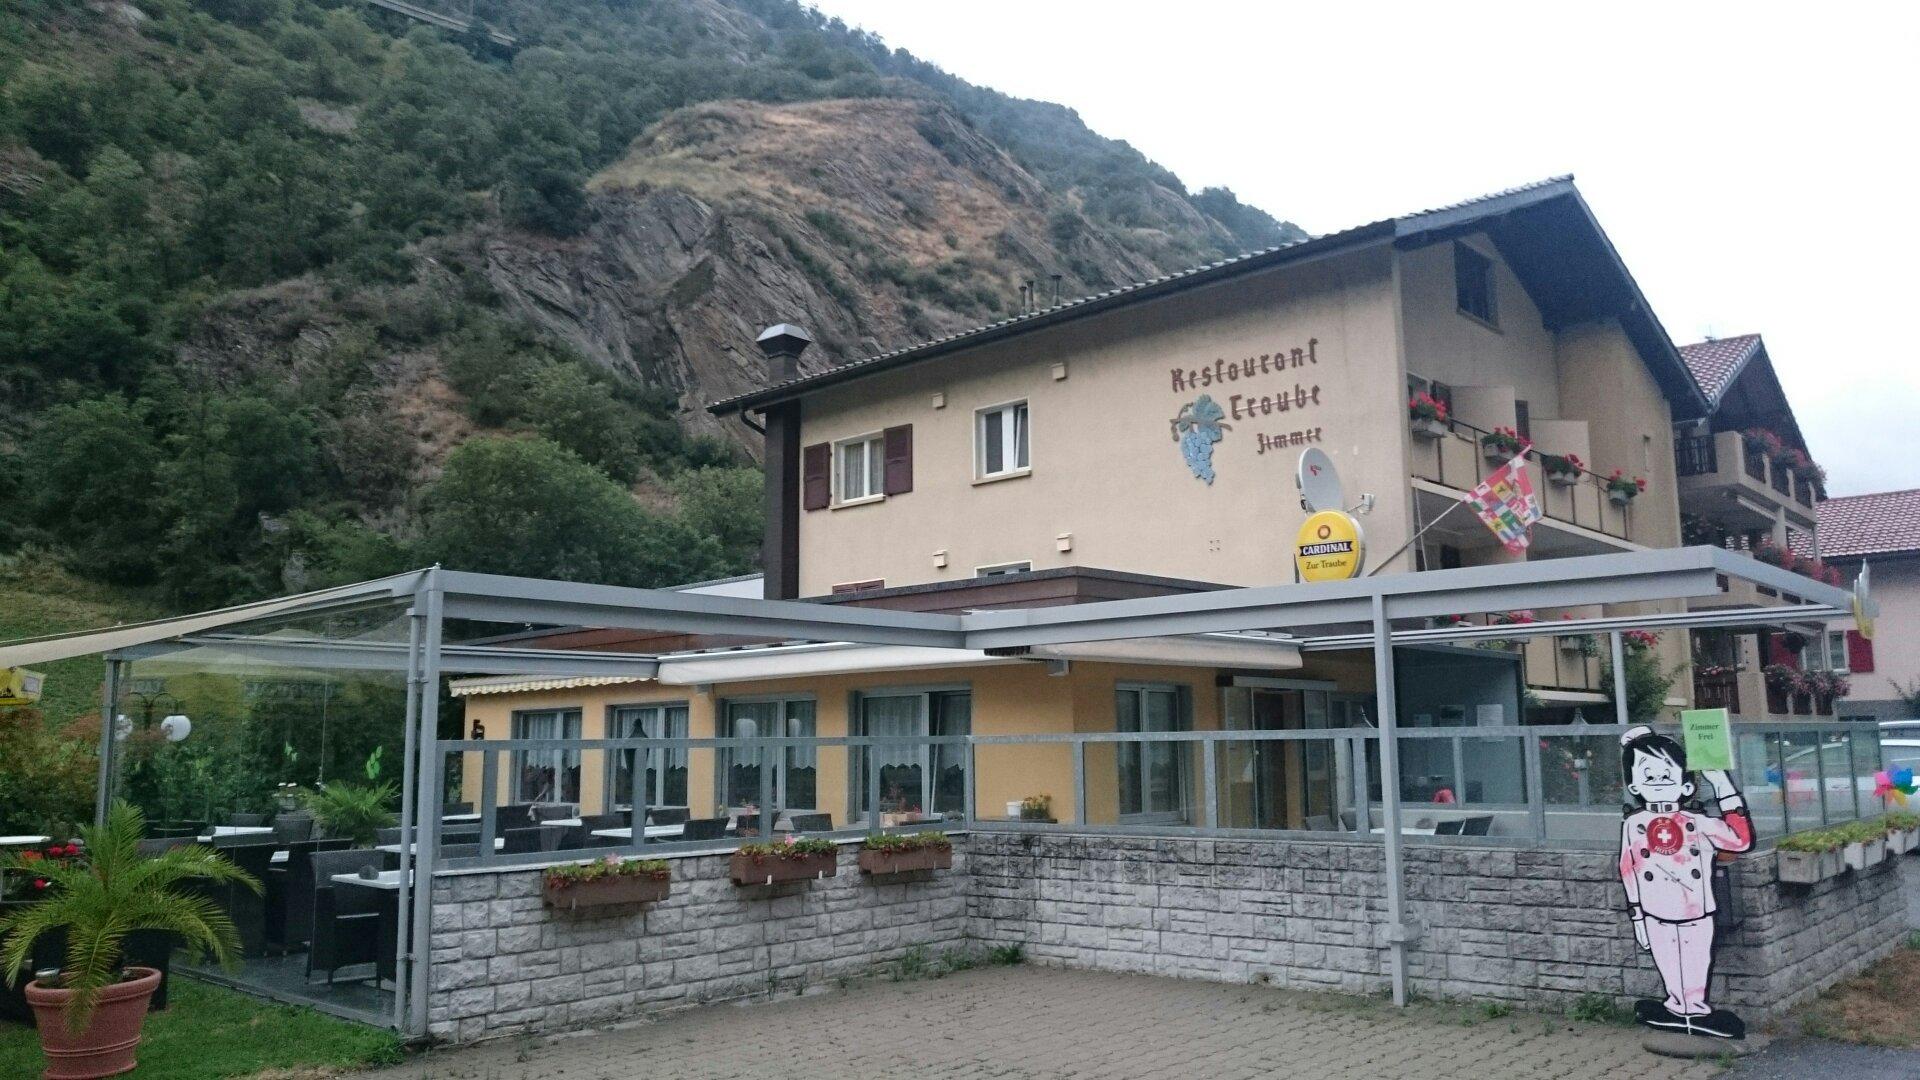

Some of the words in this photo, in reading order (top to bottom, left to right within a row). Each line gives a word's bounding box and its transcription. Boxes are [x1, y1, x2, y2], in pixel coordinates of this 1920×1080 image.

[1170, 337, 1318, 393] Restaurant
[1229, 383, 1320, 420] Traube
[1257, 427, 1322, 455] Zimmer
[1302, 542, 1350, 556] CARDINAL
[1306, 561, 1319, 570] Zur
[1321, 559, 1347, 569] Traube
[1690, 723, 1720, 731] Zimmer
